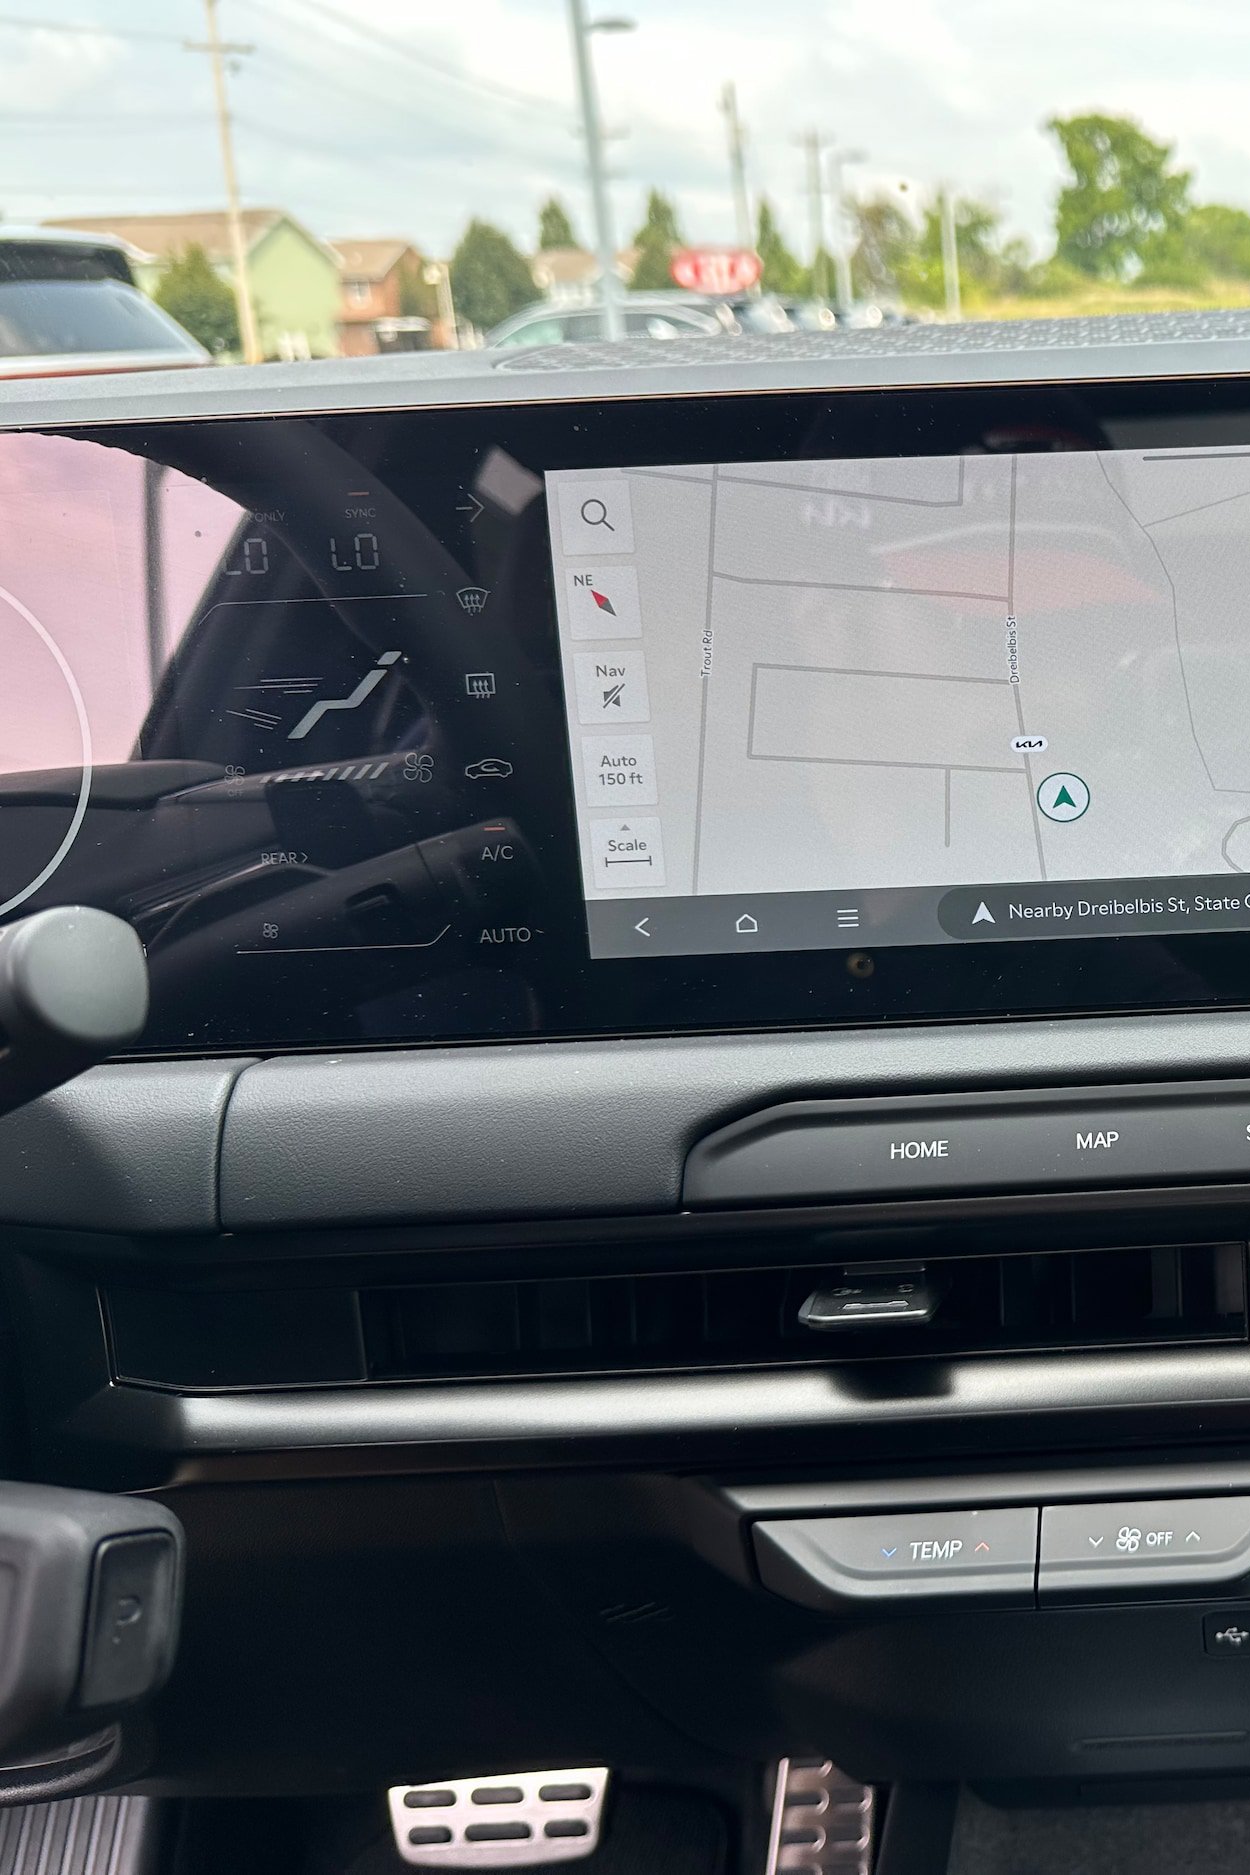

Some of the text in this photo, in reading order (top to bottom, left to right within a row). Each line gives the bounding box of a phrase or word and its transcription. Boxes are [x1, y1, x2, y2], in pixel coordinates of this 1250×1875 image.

[344, 507, 376, 519] SYNC
[573, 574, 594, 587] NE
[700, 630, 713, 677] Trout Rd
[1006, 616, 1020, 684] Dreibelbis St
[595, 665, 626, 677] Nav
[600, 755, 637, 768] Auto
[598, 772, 643, 786] 150 ft
[608, 838, 647, 852] Scale
[261, 852, 298, 865] REAR
[481, 845, 514, 861] A/C
[1008, 902, 1074, 920] Nearby
[1077, 898, 1164, 917] Dreibelbis
[1167, 896, 1191, 915] St,
[1194, 895, 1241, 912] State
[480, 927, 531, 943] AUTO
[1076, 1131, 1120, 1150] MAP
[890, 1140, 949, 1160] HOME
[1146, 1531, 1174, 1546] OFF
[909, 1540, 963, 1560] TEMP
